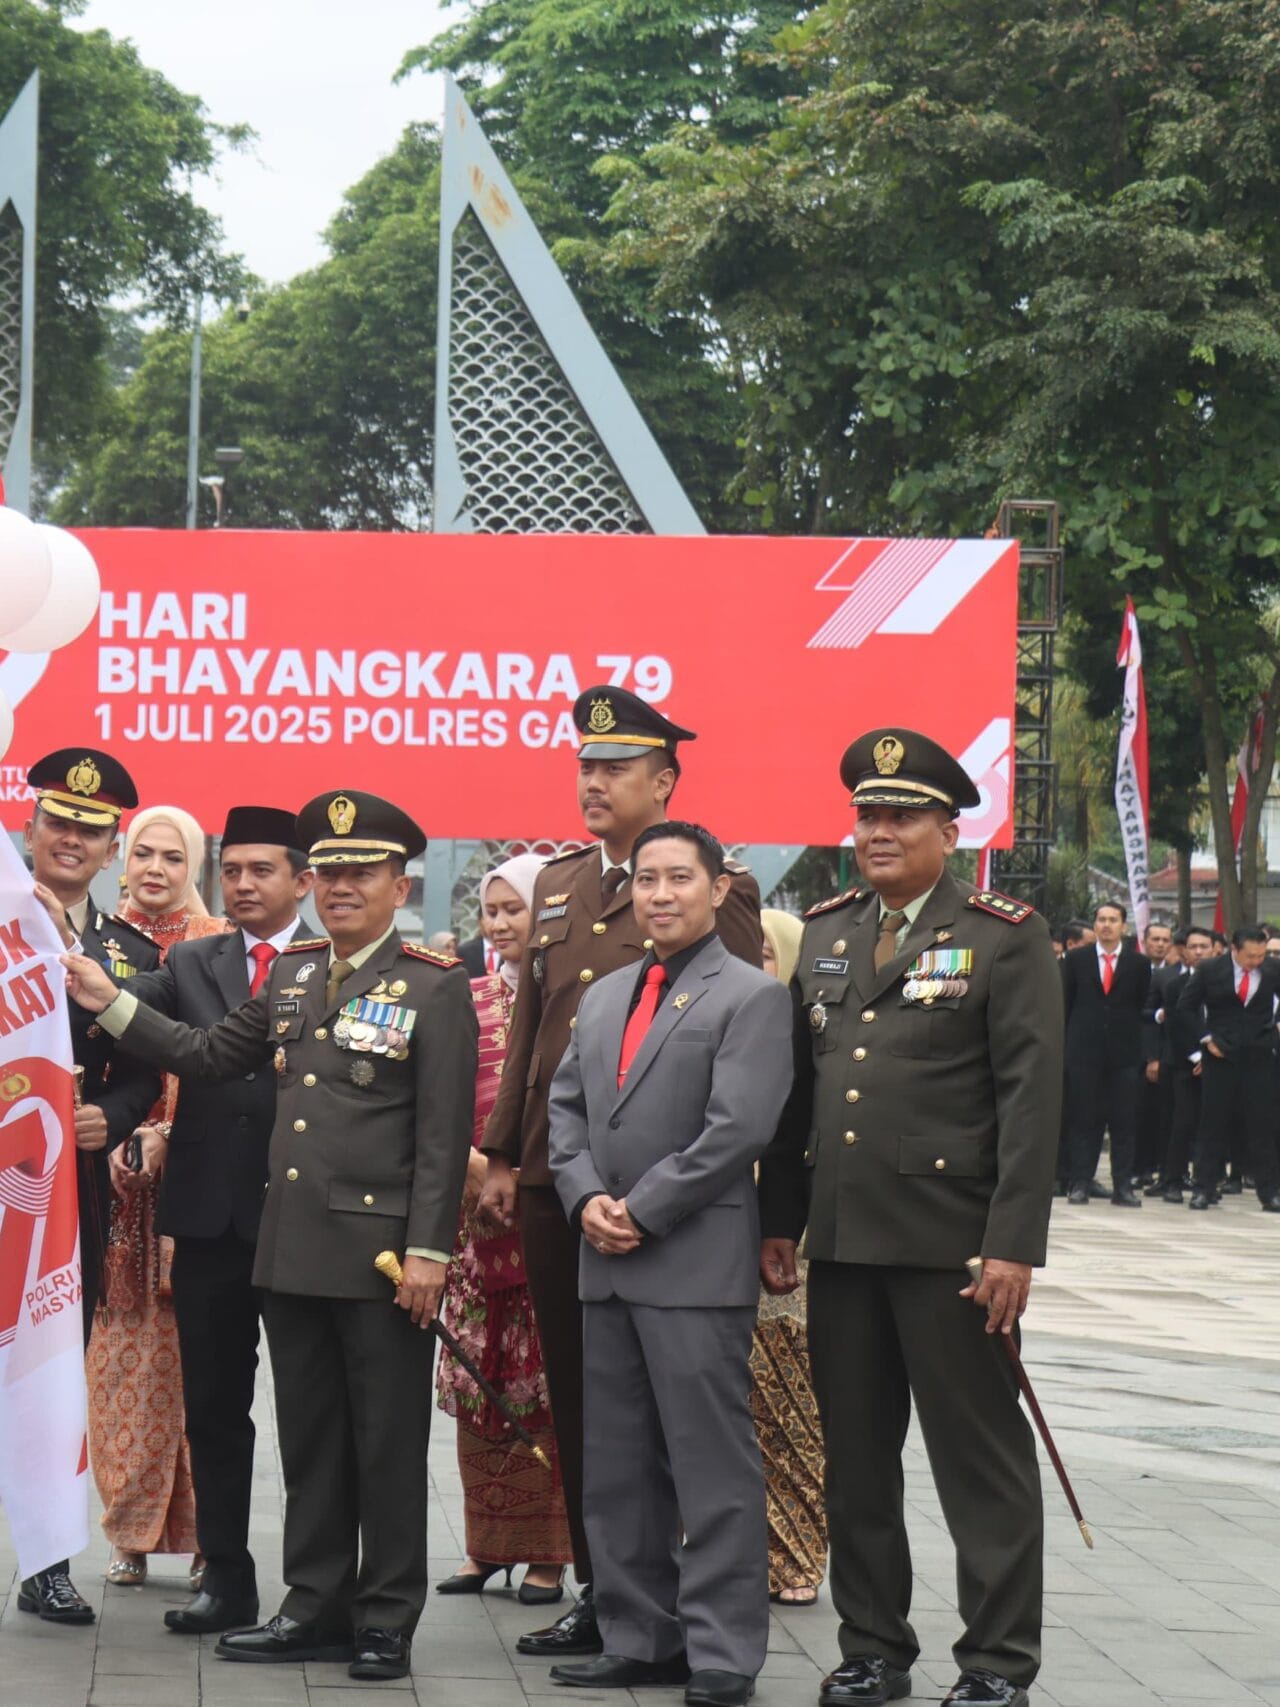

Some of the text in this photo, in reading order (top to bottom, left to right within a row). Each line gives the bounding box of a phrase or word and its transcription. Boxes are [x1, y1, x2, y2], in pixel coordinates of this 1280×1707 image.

[99, 591, 247, 641] HARI
[97, 646, 673, 704] BHAYANGKARA 79
[94, 703, 111, 740] 1
[123, 703, 213, 742] JULI
[224, 705, 332, 744] 2025
[343, 707, 508, 748] POLRES
[25, 1269, 74, 1309] POLRI
